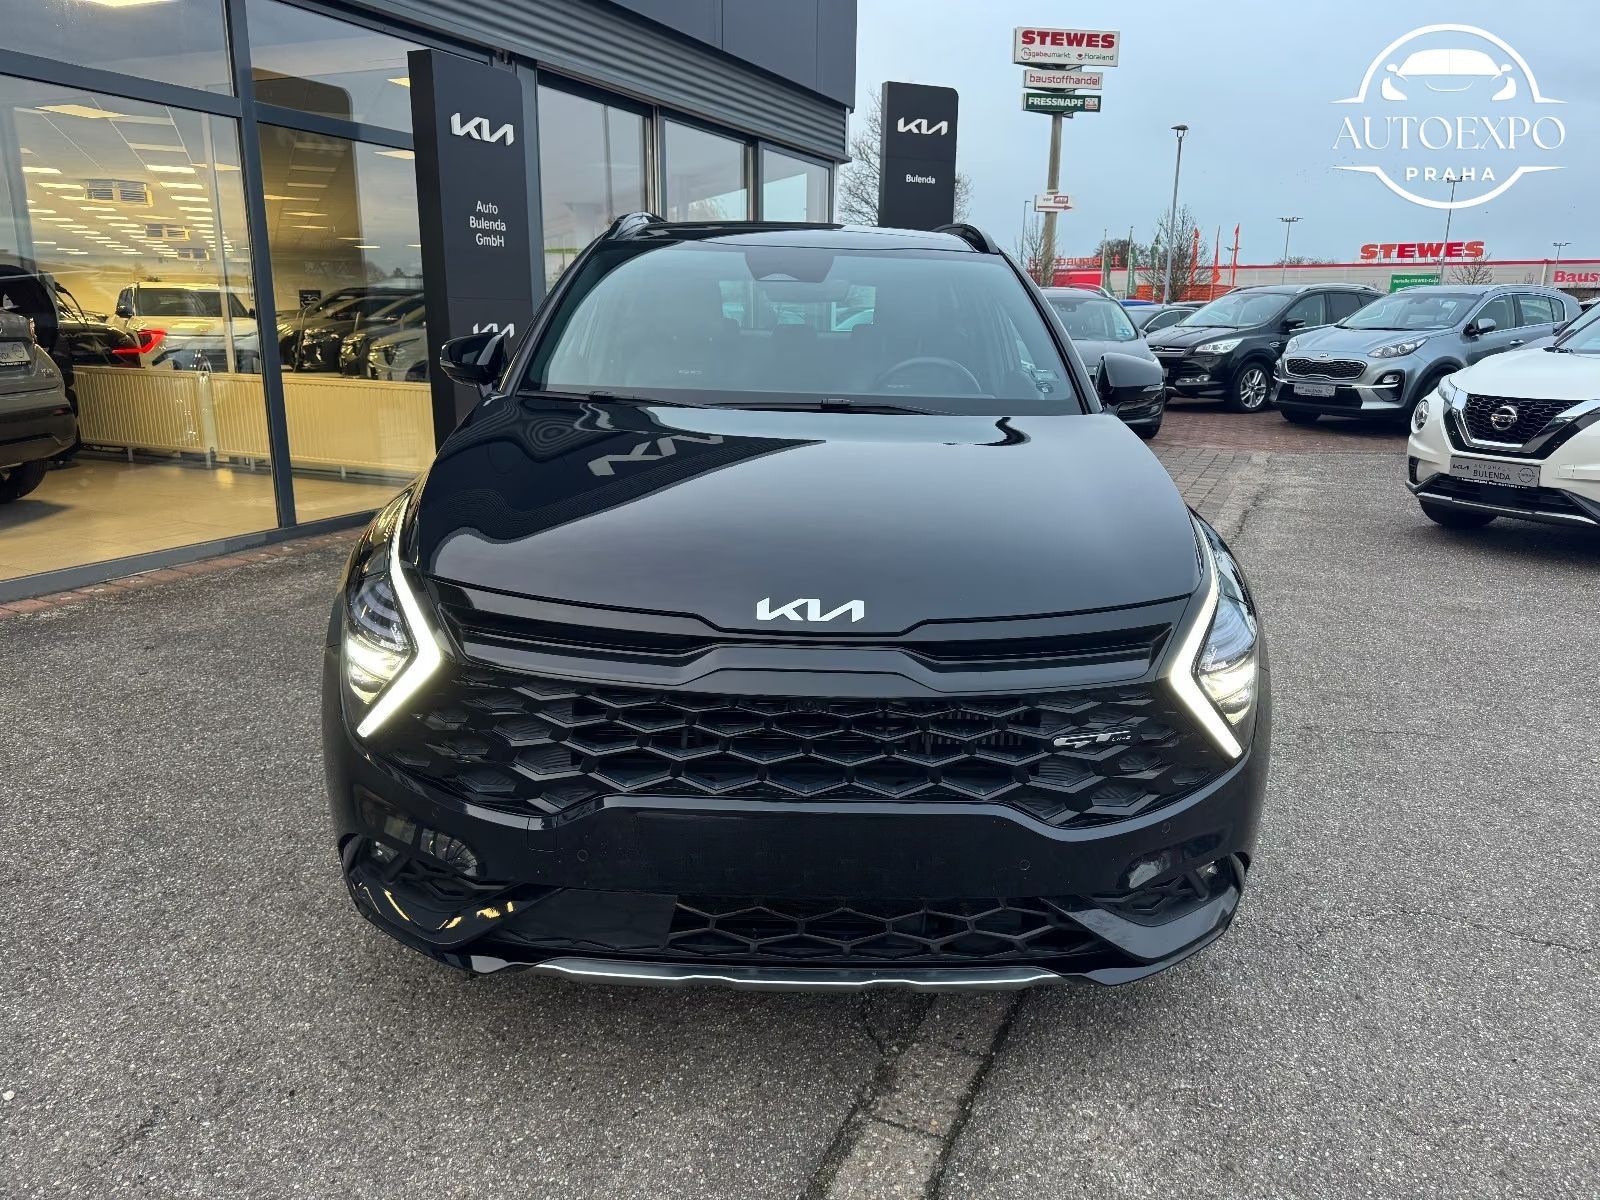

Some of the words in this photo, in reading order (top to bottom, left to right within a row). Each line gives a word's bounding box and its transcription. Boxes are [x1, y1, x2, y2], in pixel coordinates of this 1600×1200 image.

[1022, 30, 1115, 48] STEWES
[1029, 74, 1100, 86] baustoffhandel
[1028, 97, 1083, 107] FRESSNAPF
[451, 112, 515, 146] KIA
[897, 116, 948, 135] KIA
[906, 174, 936, 184] Bulenda
[476, 200, 498, 215] Auto
[469, 215, 507, 231] Bulenda
[475, 233, 505, 248] GmbH
[1360, 241, 1485, 259] STEWES
[1554, 270, 1600, 283] Baus
[1472, 469, 1511, 480] BULENDA
[757, 597, 865, 623] KIA
